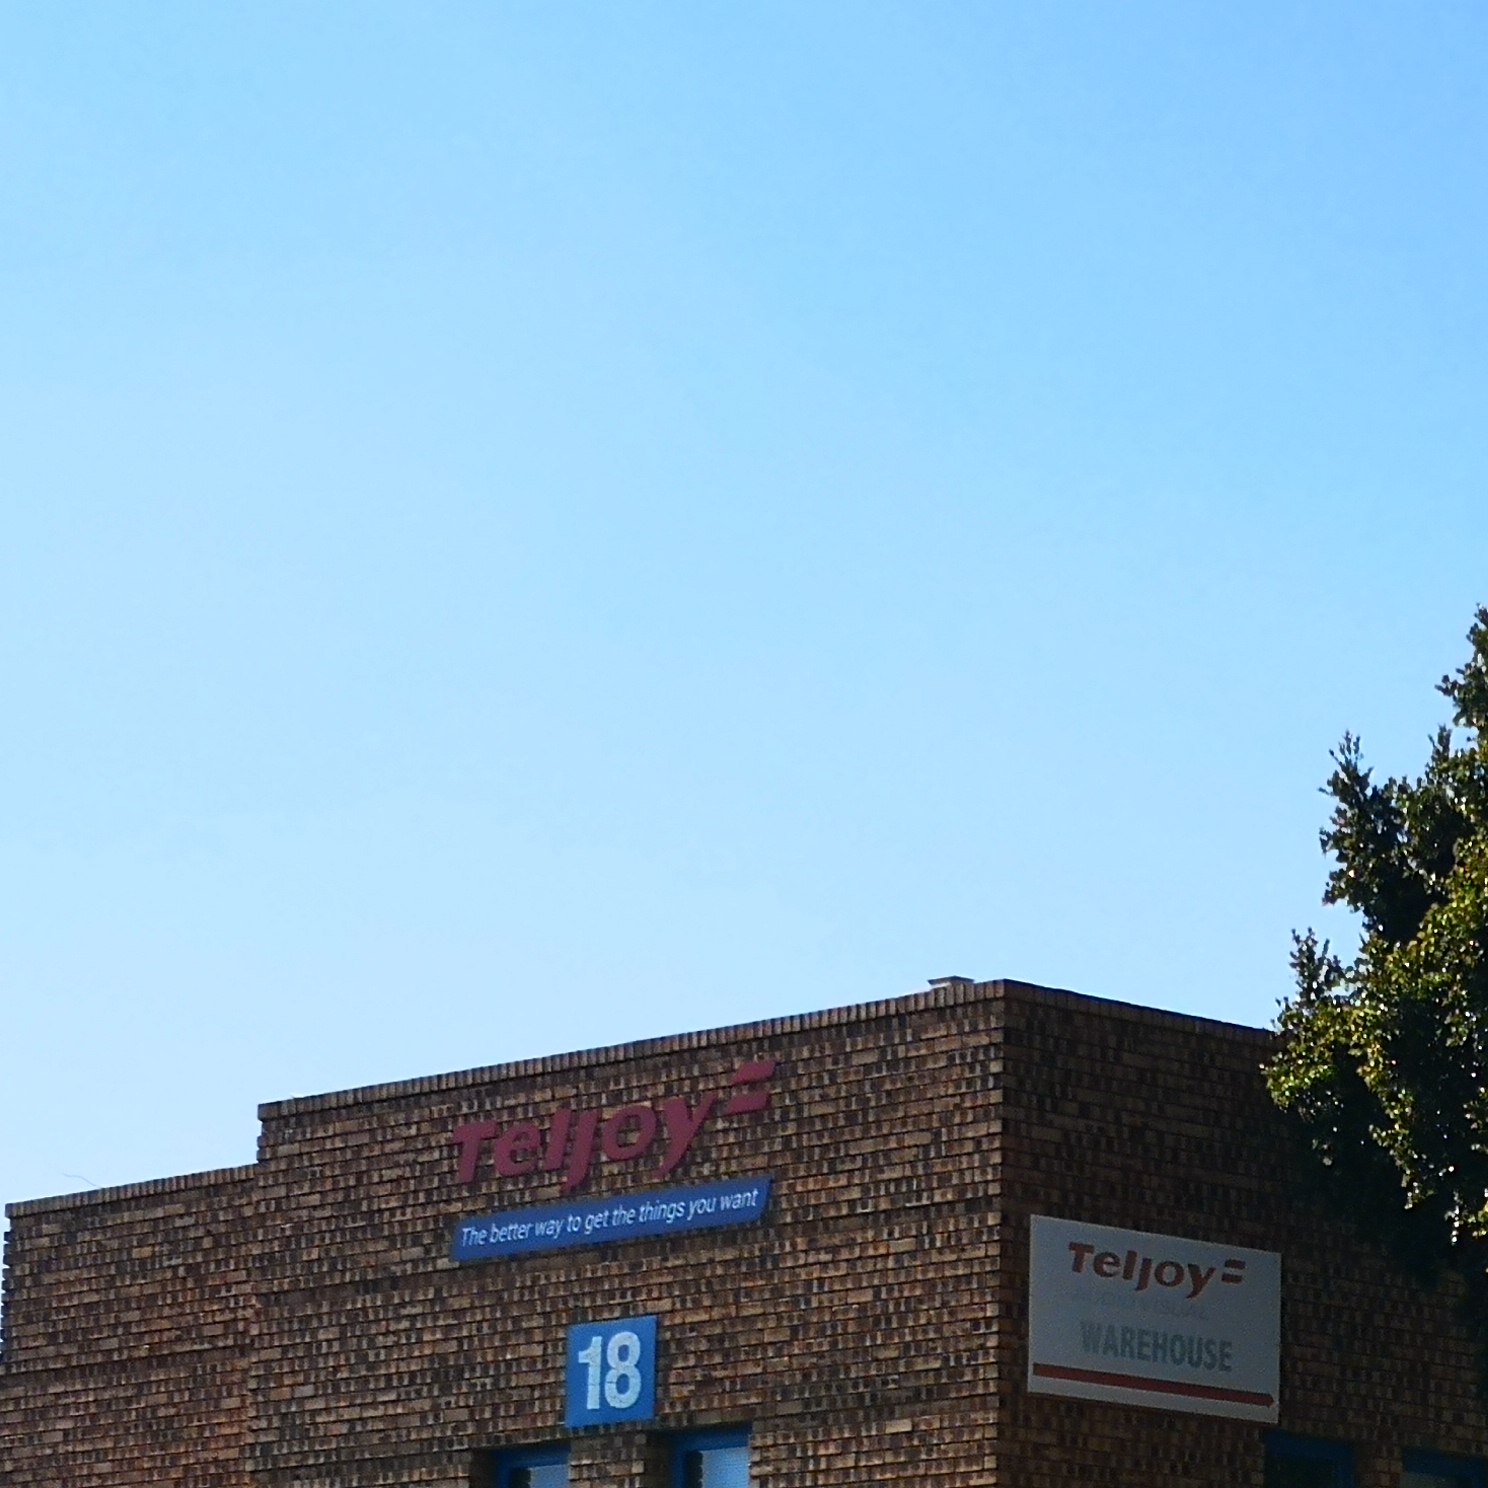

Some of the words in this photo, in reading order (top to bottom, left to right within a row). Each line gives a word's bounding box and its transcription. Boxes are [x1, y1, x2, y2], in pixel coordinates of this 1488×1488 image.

[453, 1095, 718, 1192] Teljoy
[461, 1226, 488, 1248] The
[489, 1220, 534, 1245] better
[535, 1217, 564, 1240] way
[566, 1213, 581, 1233] to
[584, 1211, 608, 1236] get
[612, 1206, 636, 1227] the
[639, 1199, 686, 1225] things
[687, 1196, 717, 1220] you
[720, 1188, 760, 1211] want
[1068, 1241, 1216, 1299] Teljoy
[578, 1331, 642, 1410] 18
[1079, 1319, 1233, 1373] WAREHOUSE
